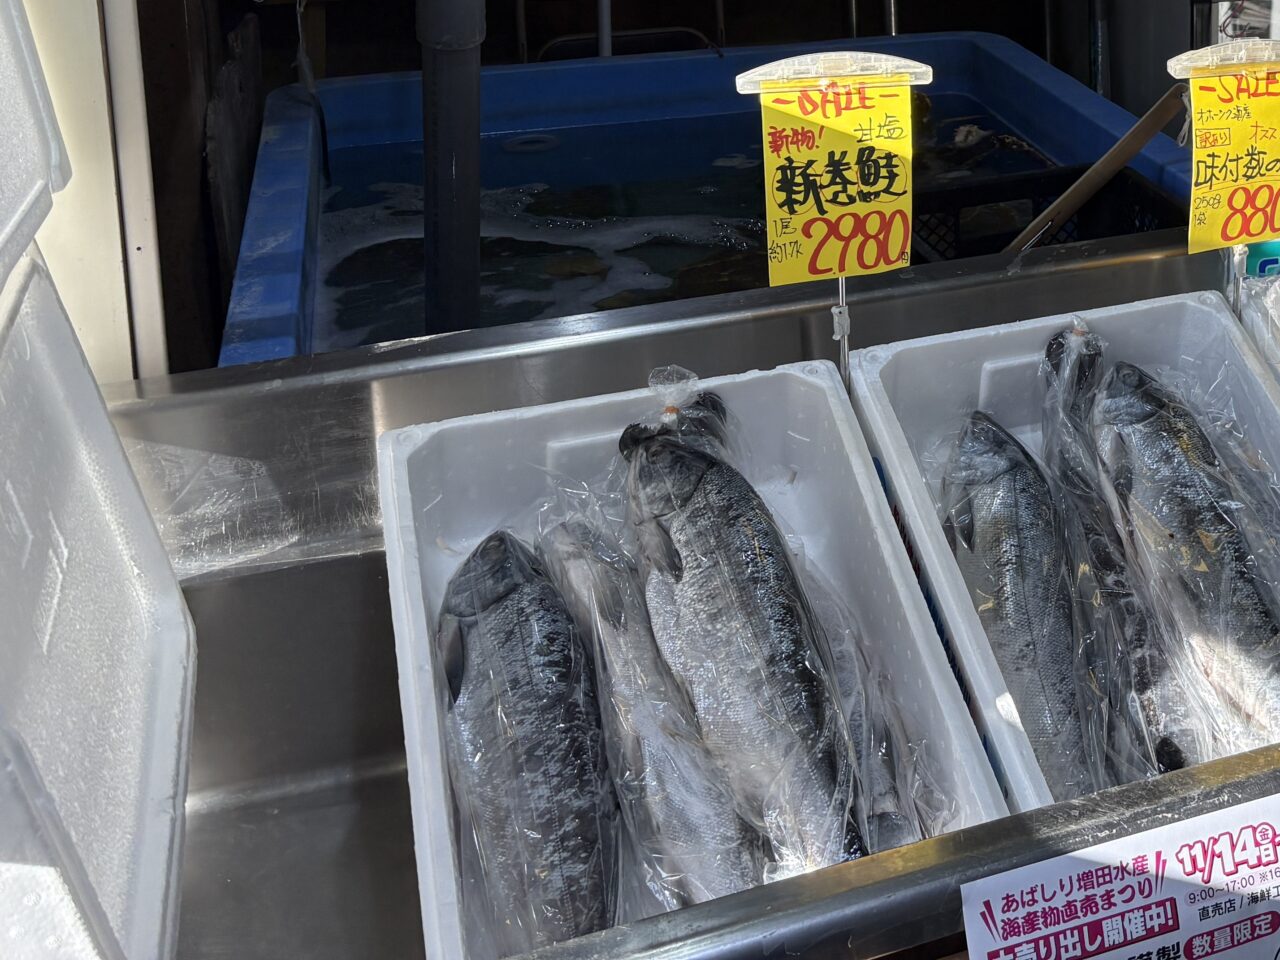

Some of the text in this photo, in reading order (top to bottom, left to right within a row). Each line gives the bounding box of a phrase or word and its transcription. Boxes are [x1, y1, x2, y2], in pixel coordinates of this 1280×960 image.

[854, 112, 908, 143] 甘塩
[1197, 104, 1252, 126] オホーツク海産
[768, 125, 825, 159] 新物!
[1198, 132, 1228, 147] 訳あり
[773, 145, 908, 216] 新巻鮭
[773, 217, 797, 238] 1尾
[1000, 854, 1151, 915] あばしり増田水産
[1000, 877, 1155, 942] 海産物直売まつり
[1198, 901, 1237, 923] 直売店
[1190, 913, 1276, 958] 数量限定
